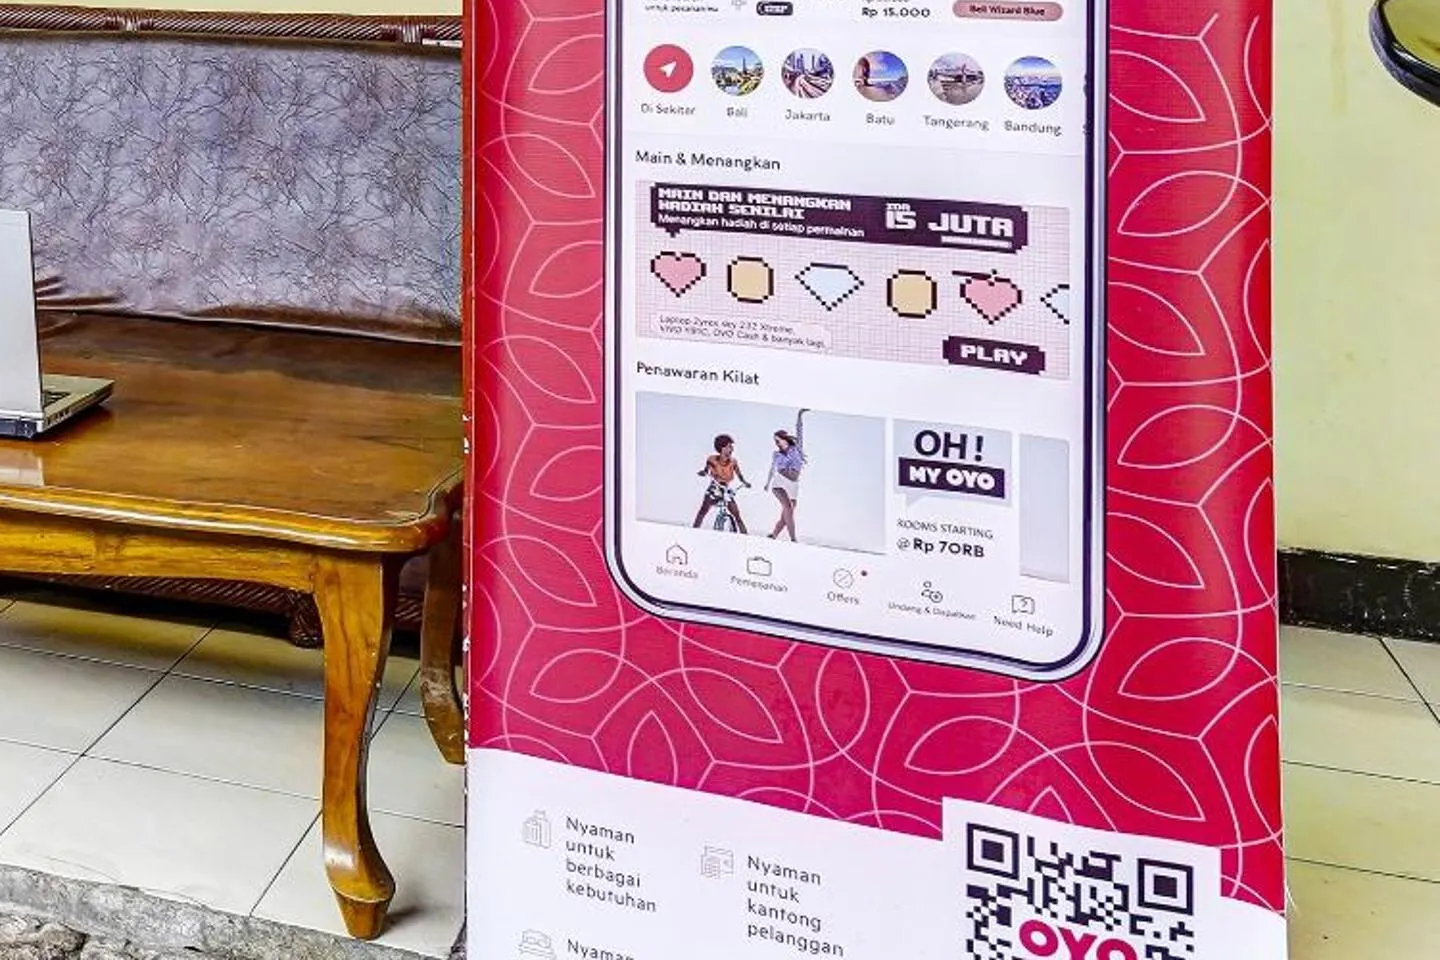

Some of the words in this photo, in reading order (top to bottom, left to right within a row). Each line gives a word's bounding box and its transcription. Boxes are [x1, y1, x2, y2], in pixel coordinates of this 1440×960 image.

[862, 7, 878, 19] Rp
[883, 7, 930, 18] 15.000
[988, 5, 1021, 16] Wizard
[1023, 6, 1045, 17] Blue
[727, 106, 748, 118] Bali
[785, 109, 830, 122] Jakarta
[866, 113, 895, 125] Batu
[923, 115, 989, 131] Tangerang
[1004, 121, 1062, 136] Bandung
[635, 150, 672, 165] Main
[676, 154, 686, 165] &
[691, 154, 781, 171] Menangkan
[658, 188, 703, 201] MAIN
[709, 190, 742, 203] DAN
[748, 193, 852, 211] MENANGKAN
[658, 200, 723, 214] HADIAH
[729, 204, 805, 219] SENILAI
[659, 215, 718, 227] Menangkan
[721, 217, 757, 230] hadiah
[760, 220, 770, 230] di
[772, 222, 804, 234] setiap
[807, 224, 864, 238] permainan
[928, 213, 1013, 237] JUTA
[960, 344, 1027, 366] PLAY
[636, 361, 719, 382] Penawaran
[723, 370, 760, 385] Kilat
[909, 465, 941, 484] MY
[946, 468, 996, 490] OYO
[897, 519, 938, 532] ROOMS
[940, 522, 993, 540] STARTING
[913, 538, 934, 554] Rp
[827, 592, 860, 605] Offers
[993, 615, 1022, 631] Need
[1026, 620, 1053, 638] Help
[565, 816, 635, 844] Nyaman
[565, 840, 615, 862] untuk
[565, 859, 641, 889] berbagai
[747, 854, 821, 885] Nyaman
[566, 880, 657, 913] kebutuhan
[747, 879, 800, 903] untuk
[747, 898, 822, 933] kantong
[747, 922, 844, 958] pelanggan
